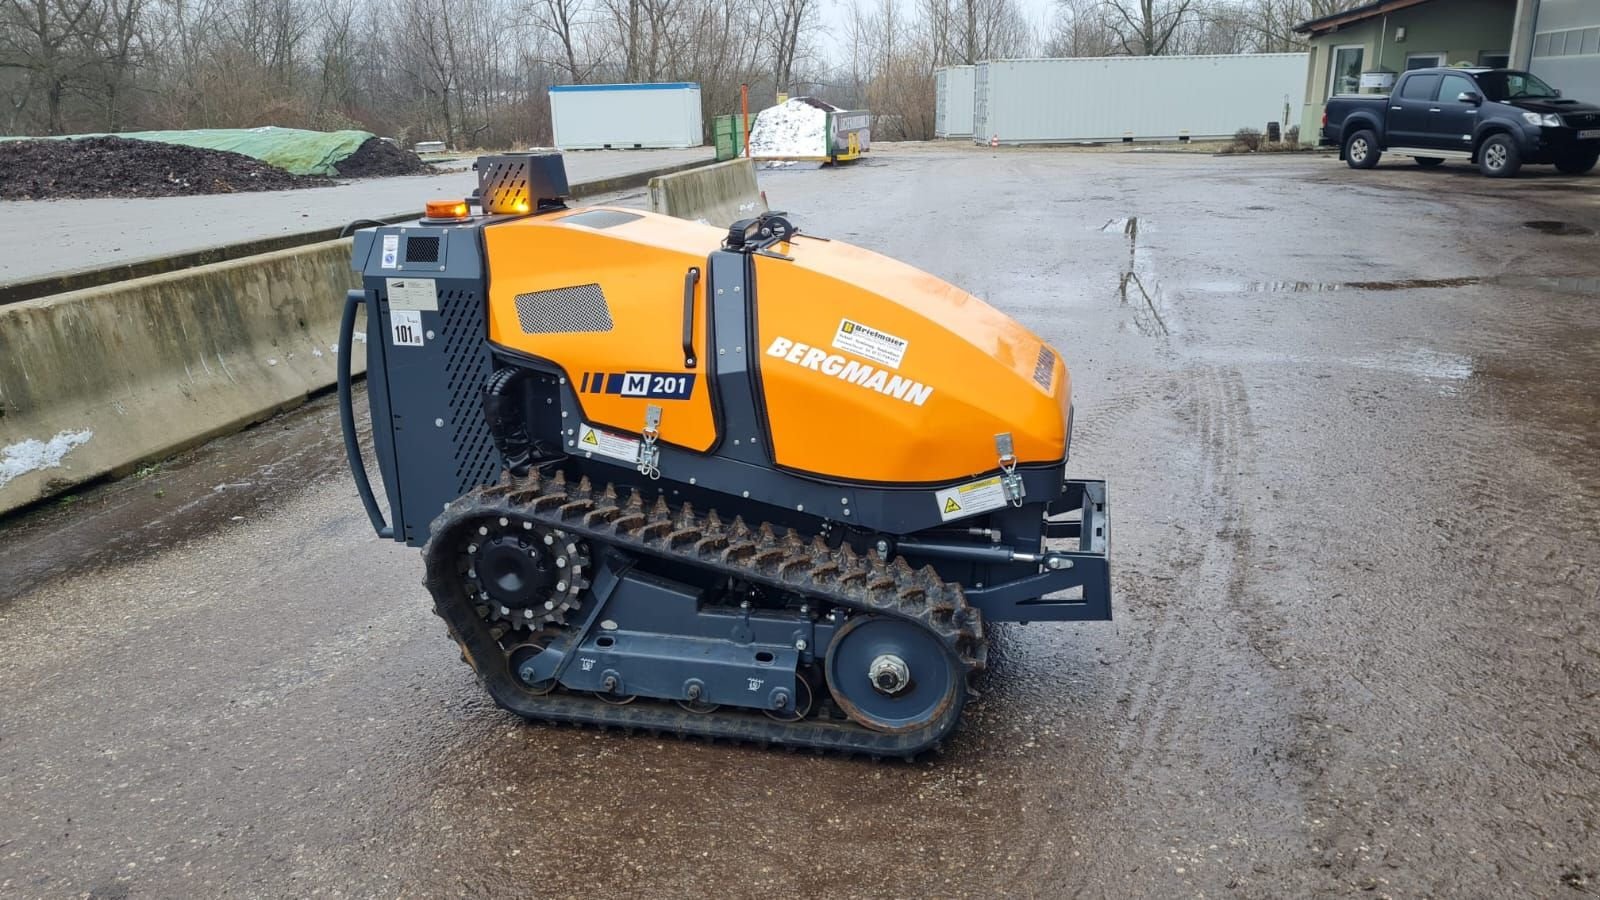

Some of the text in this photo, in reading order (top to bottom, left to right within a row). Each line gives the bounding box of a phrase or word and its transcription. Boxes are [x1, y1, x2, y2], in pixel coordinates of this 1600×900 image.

[395, 325, 413, 343] 101
[766, 336, 934, 406] BERGMANN
[629, 376, 686, 394] M 201
